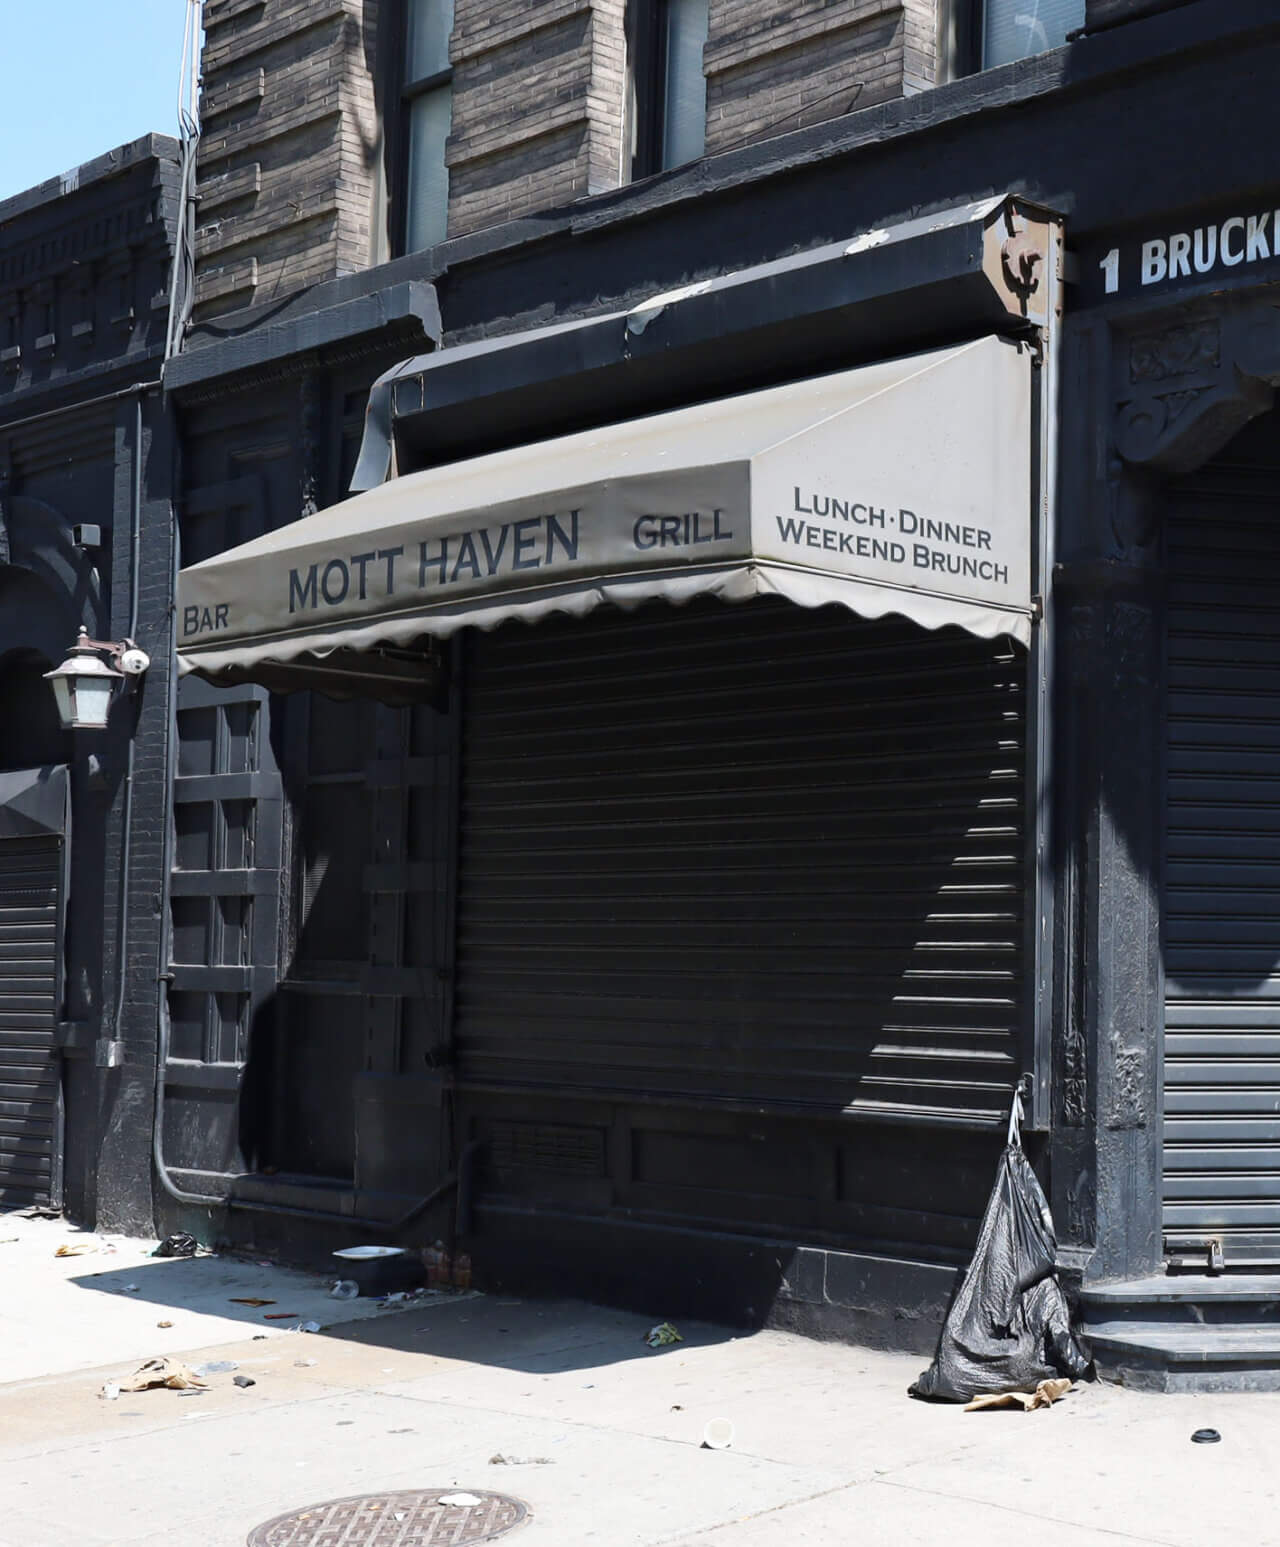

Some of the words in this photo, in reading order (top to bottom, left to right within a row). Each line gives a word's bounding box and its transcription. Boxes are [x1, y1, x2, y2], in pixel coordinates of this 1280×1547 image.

[1099, 248, 1120, 294] 1
[633, 508, 734, 550] GRILL
[793, 486, 886, 529] LUNCH
[899, 508, 992, 550] DINNER
[288, 545, 404, 614] MOTT
[418, 510, 580, 588] HAVEN
[776, 515, 906, 563] WEEKEND
[912, 543, 1009, 584] BRUNCH
[183, 602, 230, 636] BAR
